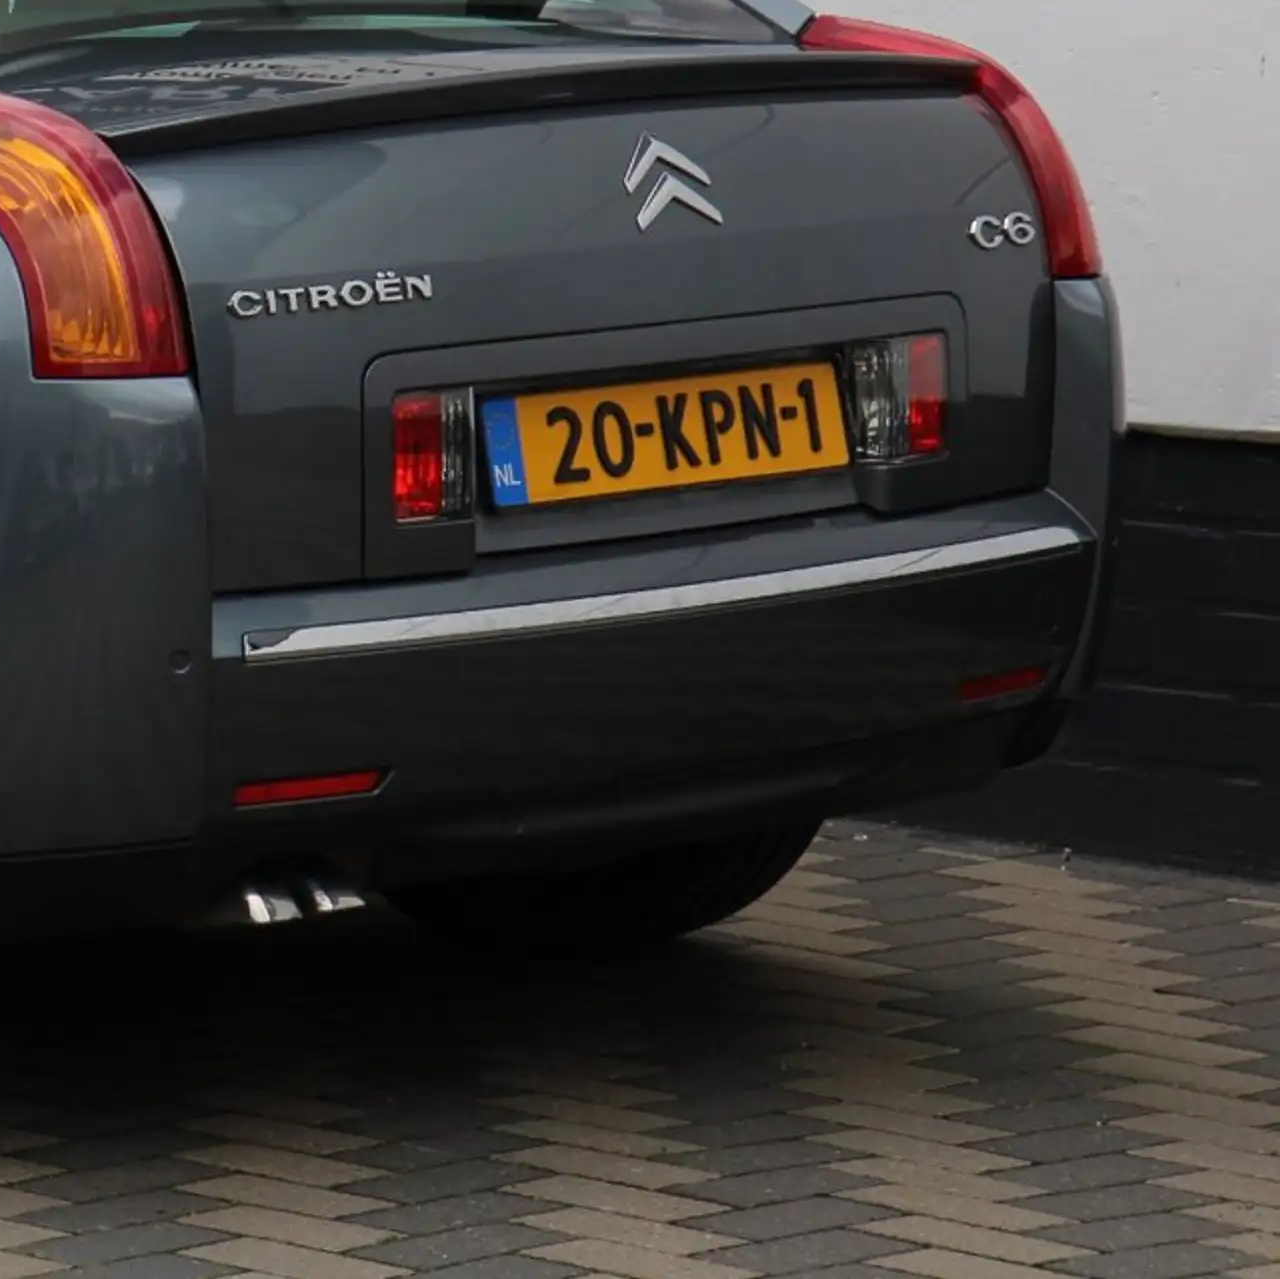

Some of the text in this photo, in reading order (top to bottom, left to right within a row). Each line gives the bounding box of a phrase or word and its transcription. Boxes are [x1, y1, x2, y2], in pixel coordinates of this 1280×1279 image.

[968, 211, 1037, 250] C6
[227, 271, 433, 317] CITROËN
[546, 378, 822, 484] 20-KPN-1
[493, 462, 522, 489] NL
